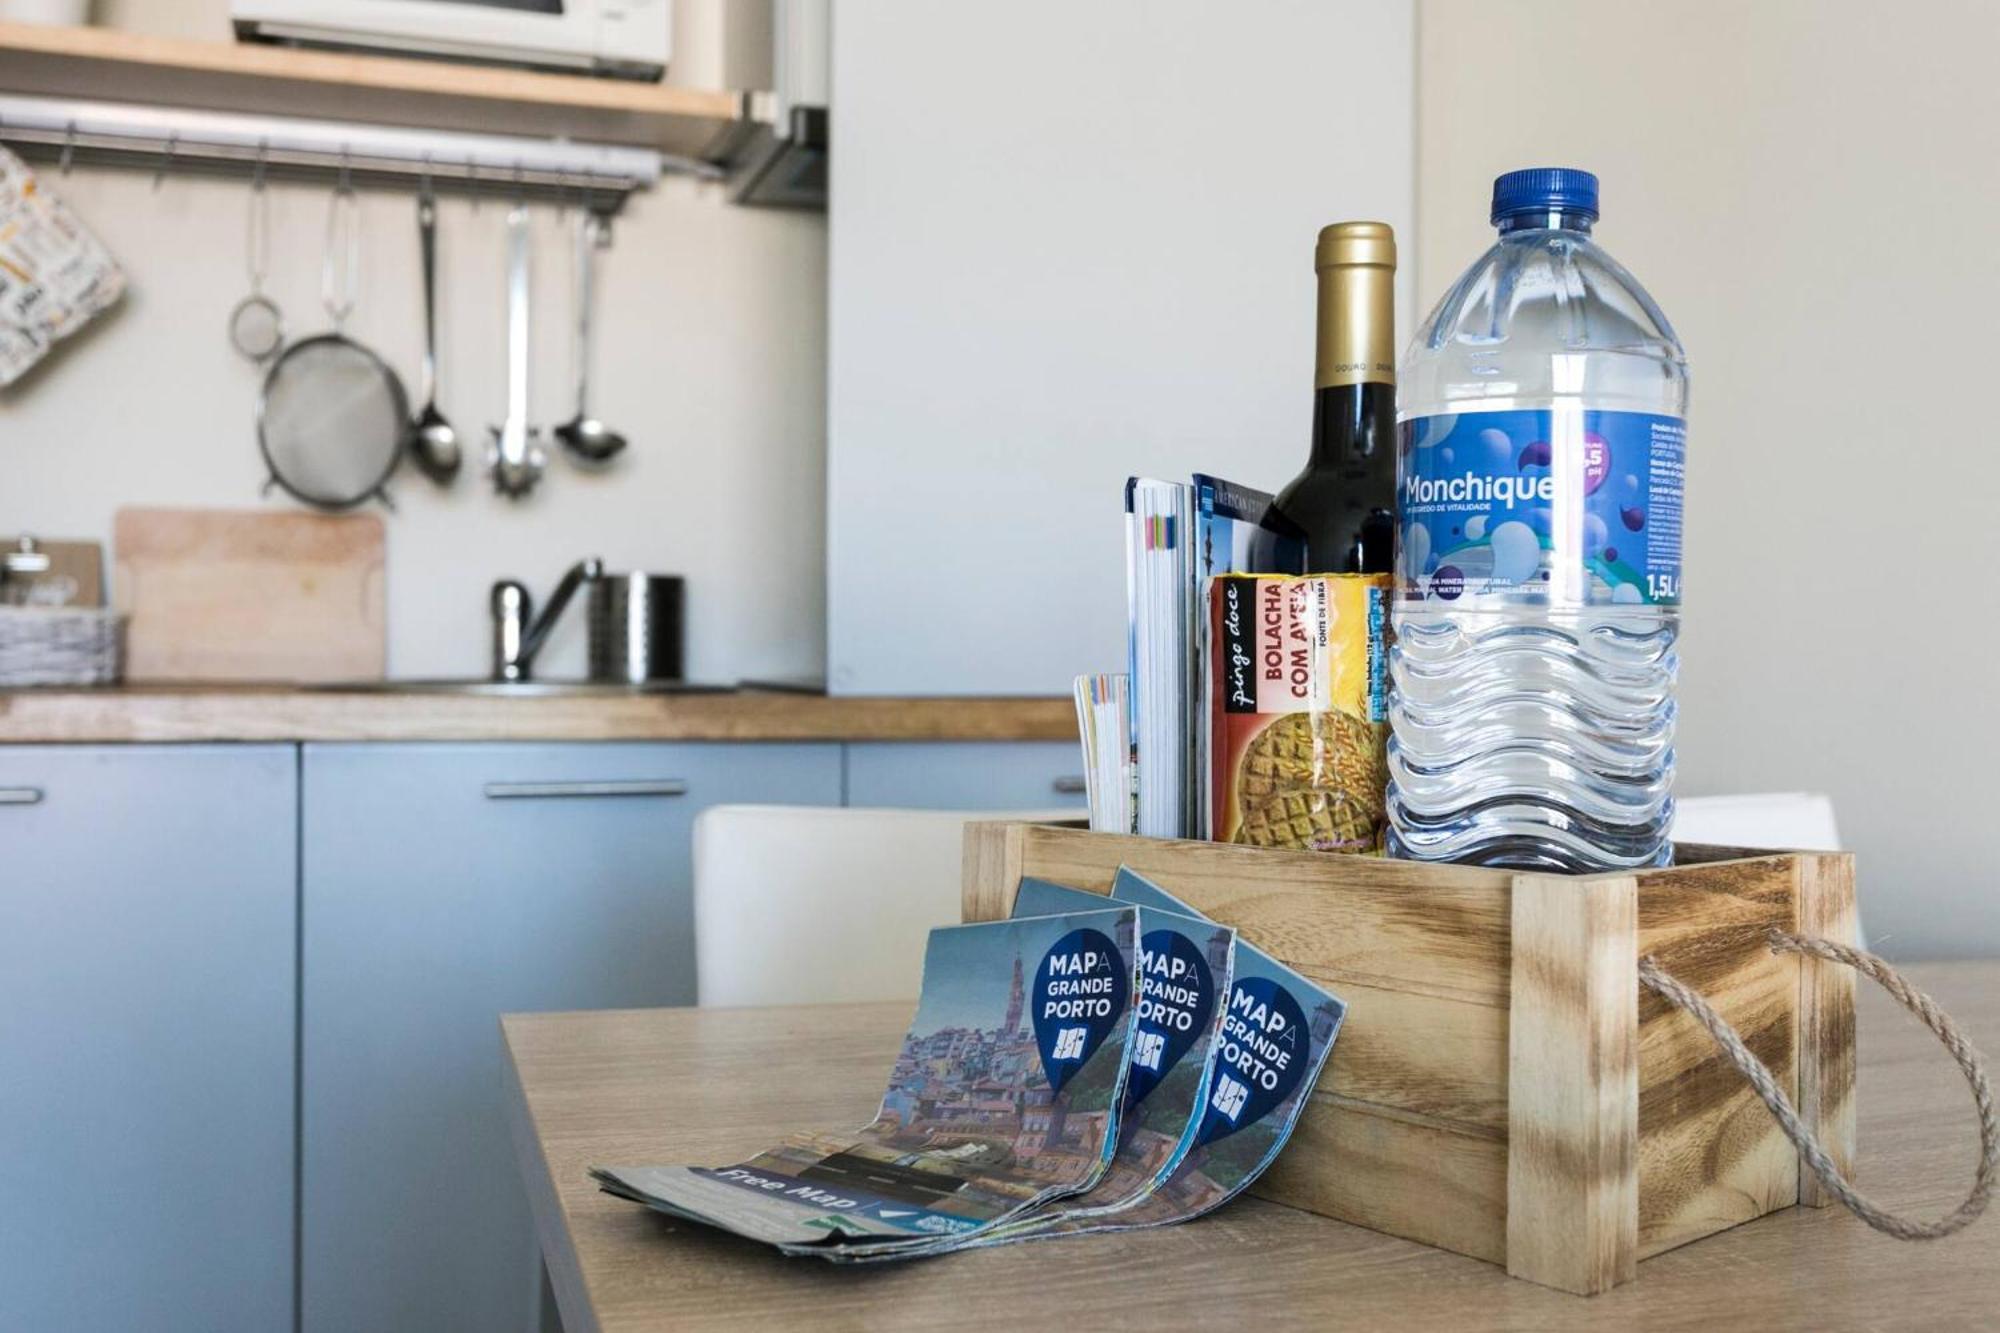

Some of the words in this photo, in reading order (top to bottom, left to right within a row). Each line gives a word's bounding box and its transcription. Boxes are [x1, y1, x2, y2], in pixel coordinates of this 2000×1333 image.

[1406, 472, 1554, 509] Monchique
[1318, 582, 1326, 606] FIBRA
[1647, 574, 1675, 601] 1,5L
[1225, 583, 1240, 636] doce
[1290, 582, 1308, 643] AVEA
[1319, 610, 1326, 620] DE
[1265, 584, 1283, 680] BOLACHA
[1319, 625, 1327, 647] FONTE
[1229, 645, 1255, 706] pingo
[1291, 649, 1309, 698] COM
[1049, 951, 1112, 976] MAPA
[1047, 977, 1113, 996] GRANDE
[1142, 978, 1199, 1008] RANDE
[1044, 998, 1111, 1019] PORTO
[1139, 1000, 1192, 1031] ORTO
[1231, 987, 1296, 1049] MAPA
[1224, 1015, 1291, 1070] GRANDE
[716, 1169, 786, 1191] Free
[785, 1186, 857, 1209] Map
